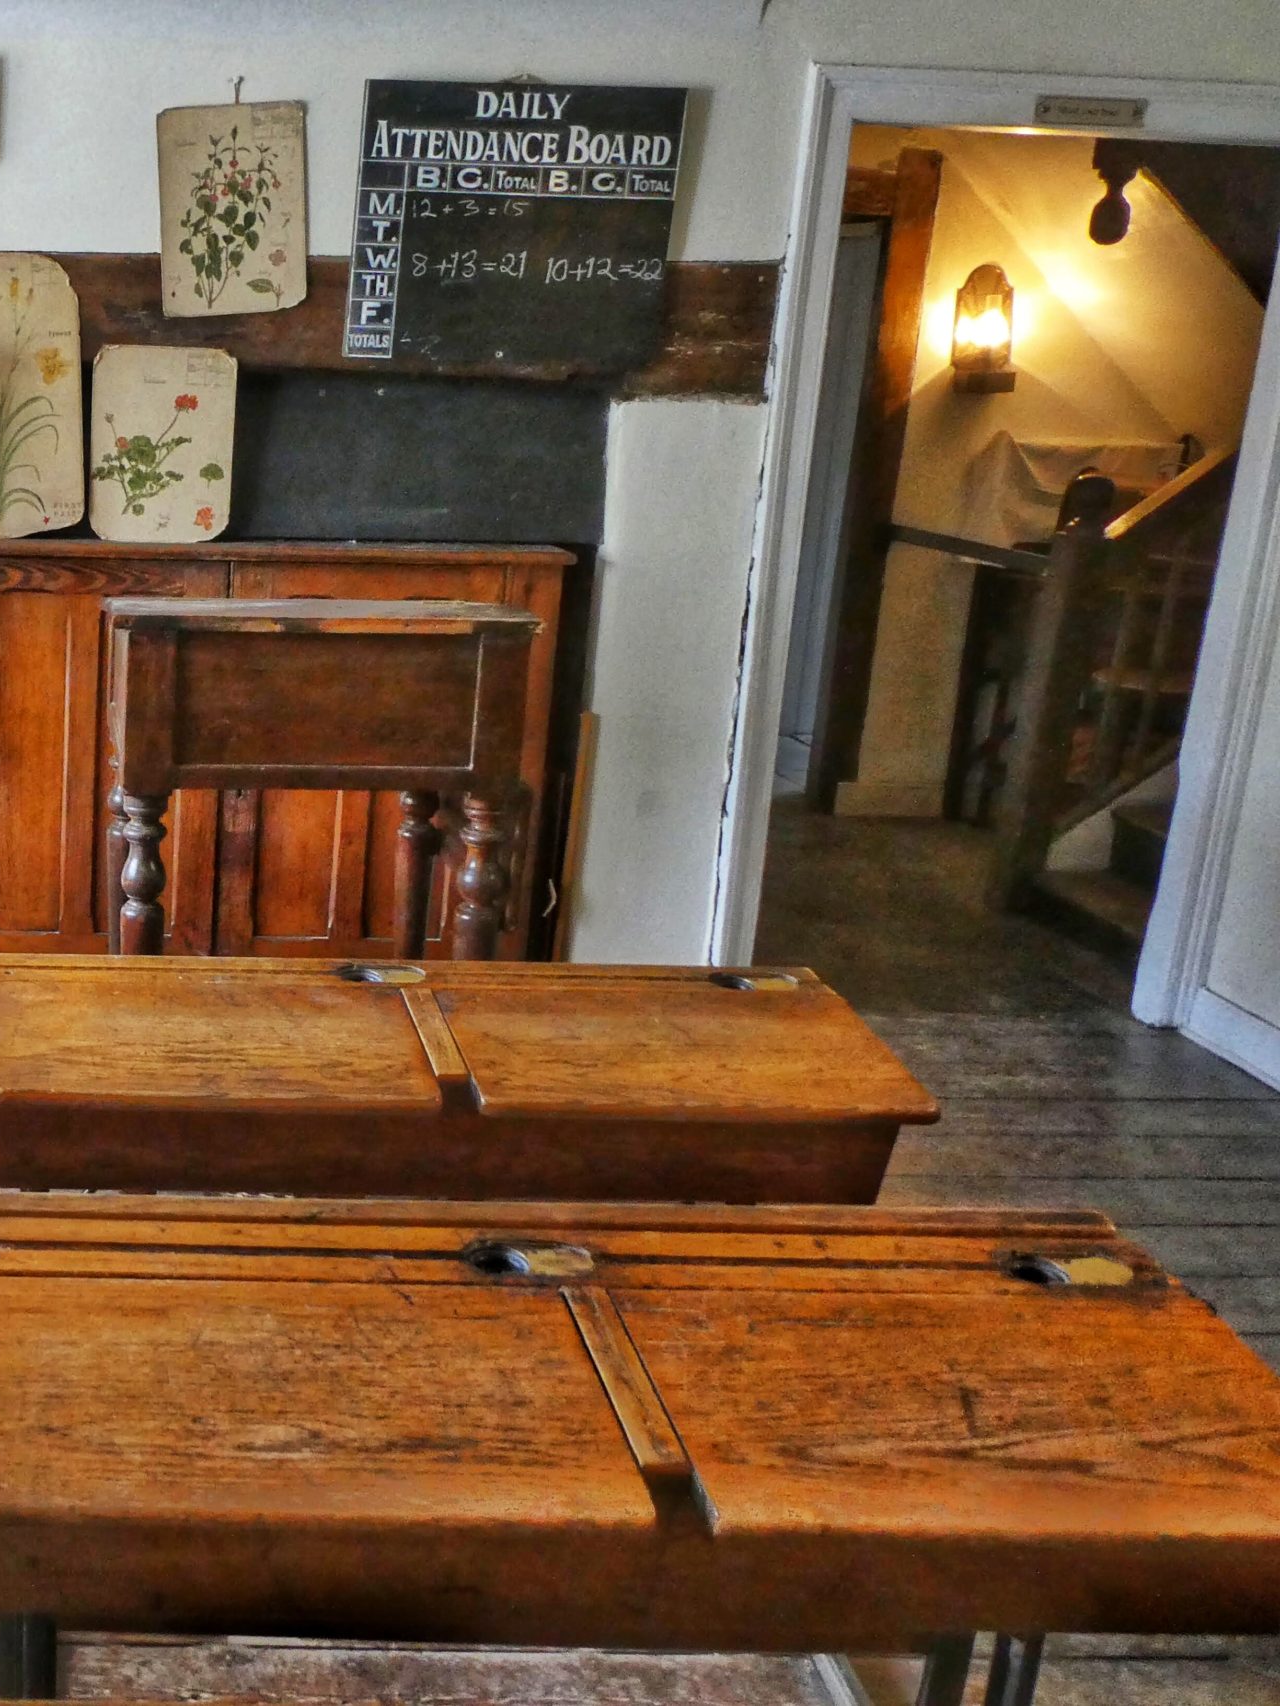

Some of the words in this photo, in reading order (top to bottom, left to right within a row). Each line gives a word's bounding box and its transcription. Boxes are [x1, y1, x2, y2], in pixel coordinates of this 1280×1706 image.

[475, 91, 571, 120] DAILY
[371, 120, 560, 163] ATTENDANCE
[567, 125, 672, 166] BOARD
[369, 192, 401, 215] M.
[412, 198, 437, 218] 12
[458, 199, 480, 217] 3
[503, 199, 530, 216] 15
[372, 220, 397, 242] T.
[365, 247, 397, 269] W.
[361, 274, 393, 297] TH.
[360, 301, 390, 325] F.
[348, 334, 390, 348] TOTALS
